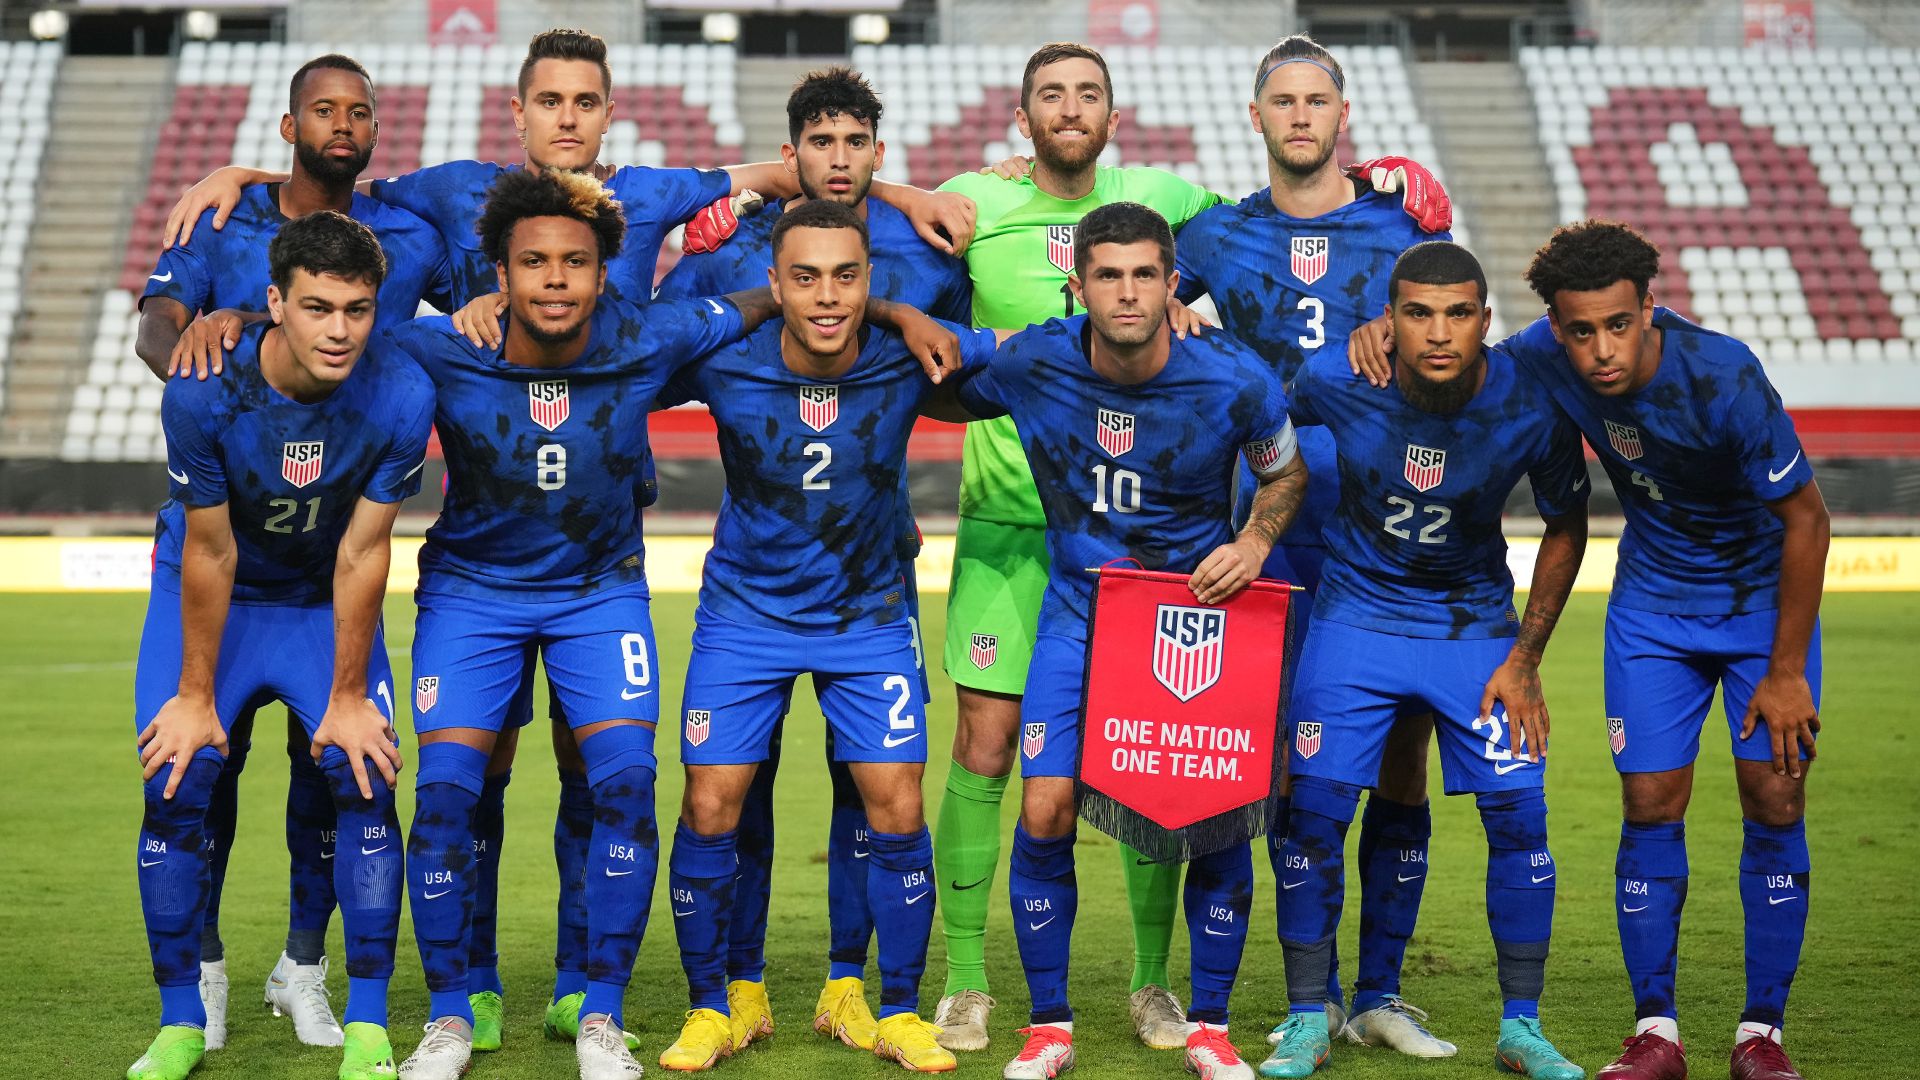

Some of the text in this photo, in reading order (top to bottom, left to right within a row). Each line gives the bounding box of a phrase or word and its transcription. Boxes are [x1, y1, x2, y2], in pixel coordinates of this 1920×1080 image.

[717, 209, 729, 227] COAST
[1293, 239, 1326, 257] USA
[1060, 283, 1074, 318] 1
[1297, 297, 1325, 348] 3
[532, 382, 566, 402] USA
[802, 387, 836, 403] USA
[1100, 411, 1133, 431] USA
[1606, 422, 1638, 440] USA
[286, 445, 321, 462] USA
[1246, 438, 1275, 455] USA
[803, 442, 832, 490] 2
[1408, 447, 1444, 467] USA
[537, 444, 566, 491] 8
[1092, 464, 1142, 513] 10
[1631, 470, 1664, 500] 4
[264, 496, 322, 534] 21
[1384, 495, 1452, 544] 22
[1160, 609, 1221, 647] USA
[974, 635, 996, 650] USA
[620, 633, 650, 686] 8
[418, 678, 437, 692] USA
[883, 675, 915, 730] 2
[688, 711, 709, 726] USA
[1026, 724, 1045, 738] USA
[1104, 717, 1256, 753] ONE NATION.
[1299, 723, 1320, 738] USA
[1111, 747, 1243, 782] ONE TEAM.
[320, 830, 337, 843] US
[363, 825, 387, 839] USA
[855, 829, 869, 842] US
[146, 838, 167, 853] USA
[472, 839, 487, 853] SA
[609, 843, 635, 862] USA
[1285, 854, 1310, 870] USA
[1400, 849, 1425, 863] USA
[1530, 852, 1551, 867] USA
[424, 870, 453, 885] USA
[903, 871, 926, 888] USA
[1766, 874, 1794, 889] USA
[673, 887, 694, 904] USA
[1625, 878, 1648, 896] USA
[1024, 898, 1052, 912] USA
[1209, 905, 1234, 923] USA
